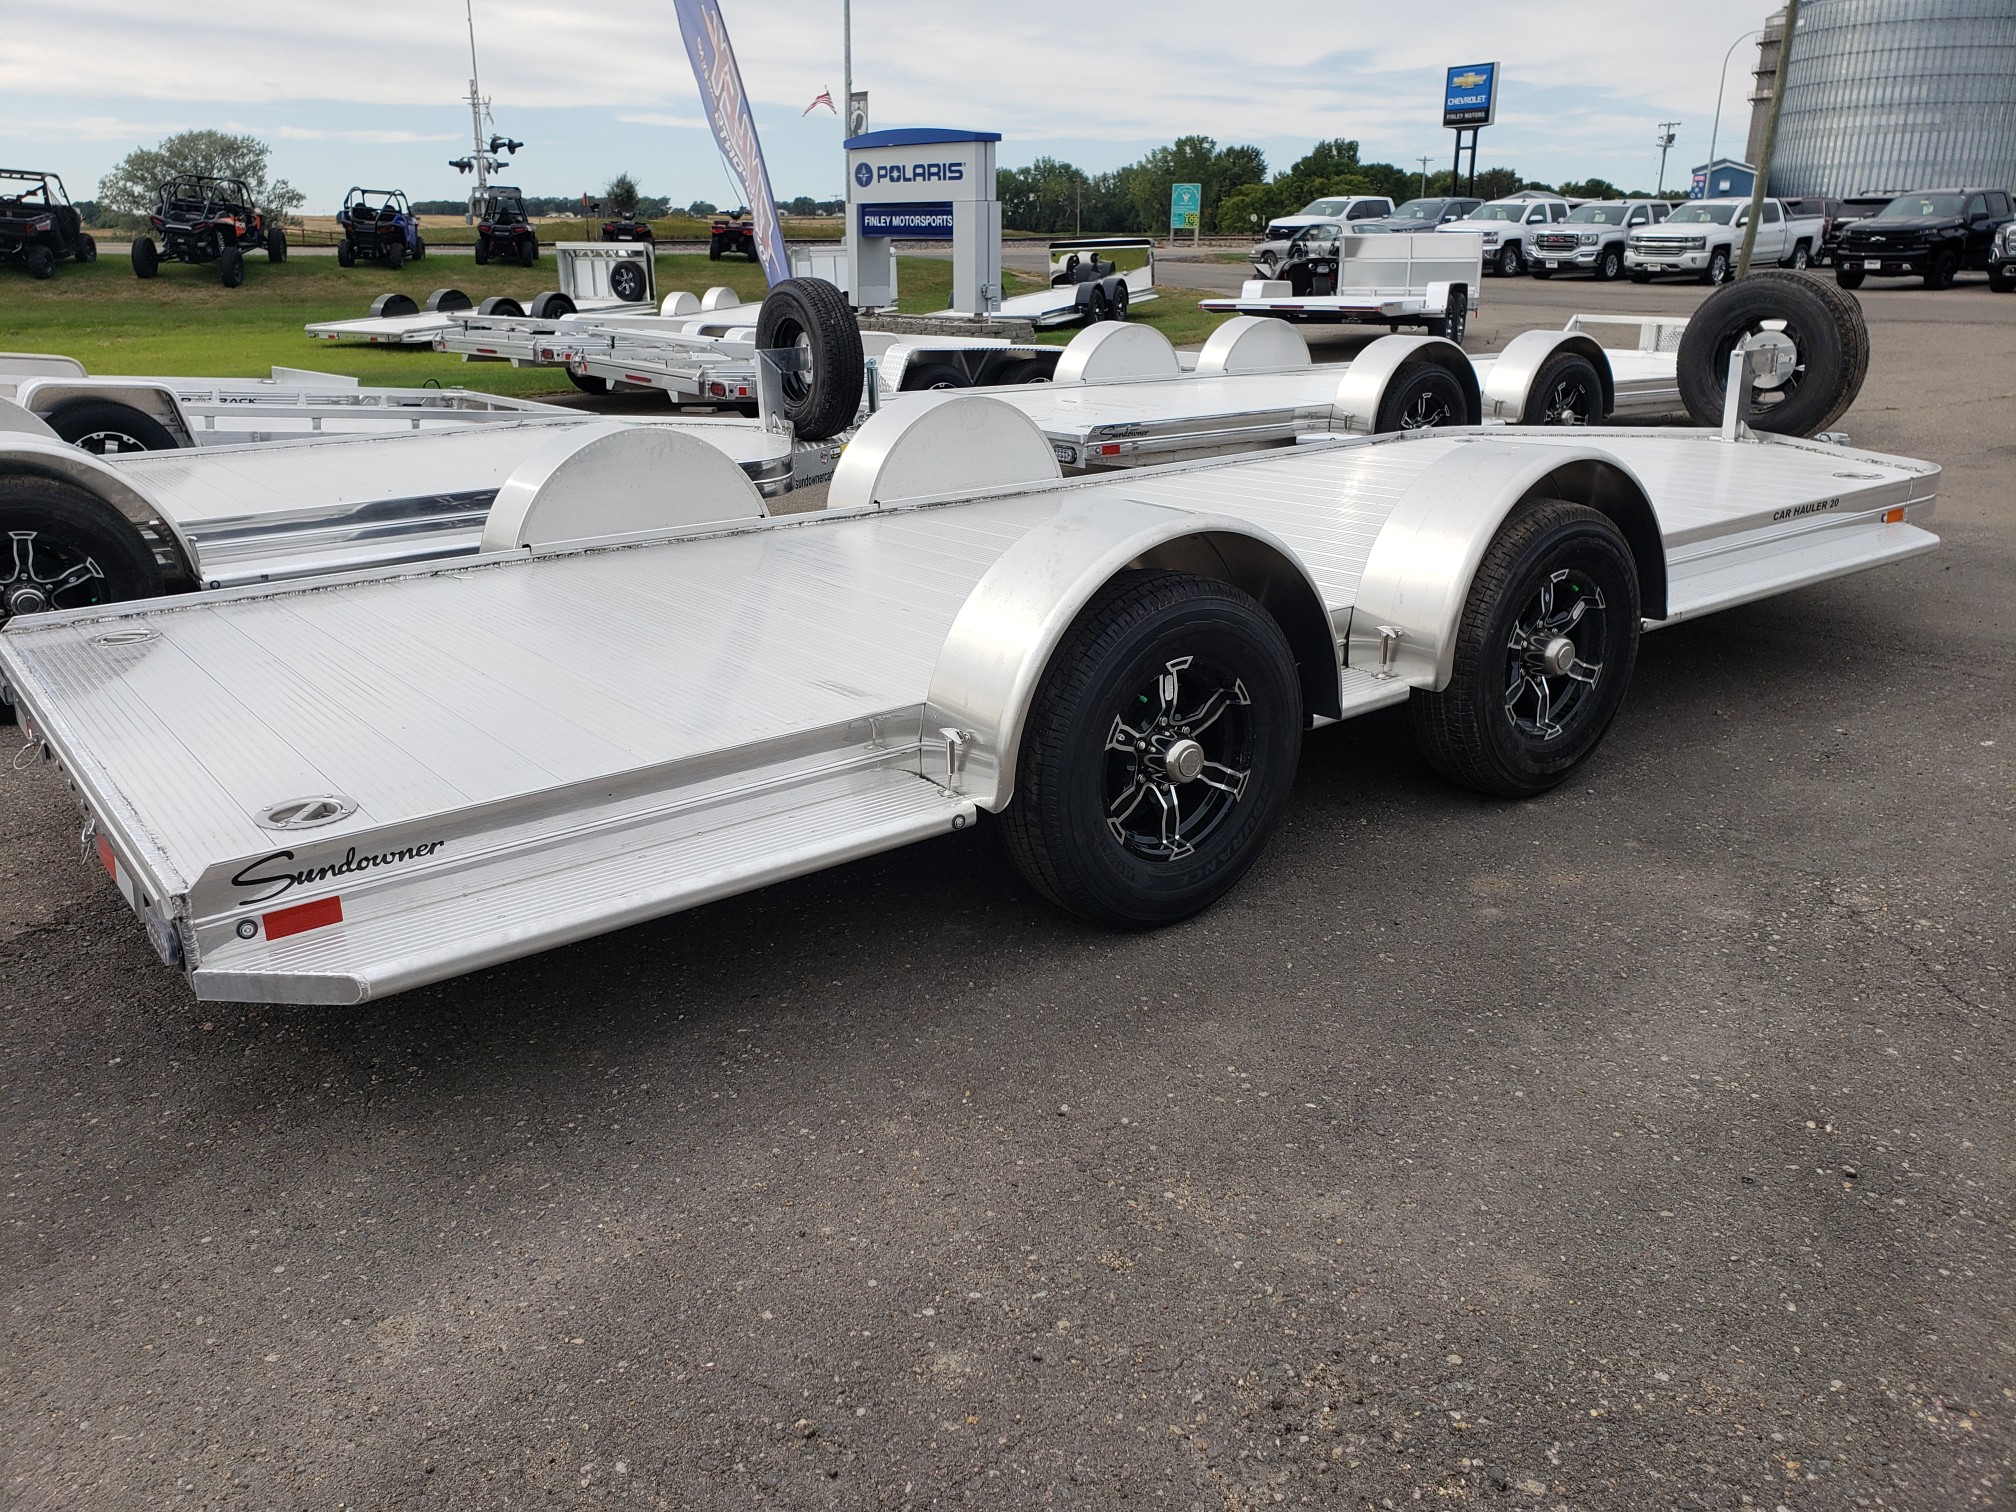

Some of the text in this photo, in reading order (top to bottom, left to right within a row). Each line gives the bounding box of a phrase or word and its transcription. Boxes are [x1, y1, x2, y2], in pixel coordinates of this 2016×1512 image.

[1447, 95, 1487, 105] CHEVROLET
[877, 162, 963, 183] POLARIS
[864, 215, 953, 227] FINLEY MOTORSPORTS
[1100, 425, 1149, 441] Sundowner
[1773, 498, 1839, 520] CAR HAULER 20
[231, 840, 444, 906] Sundowner
